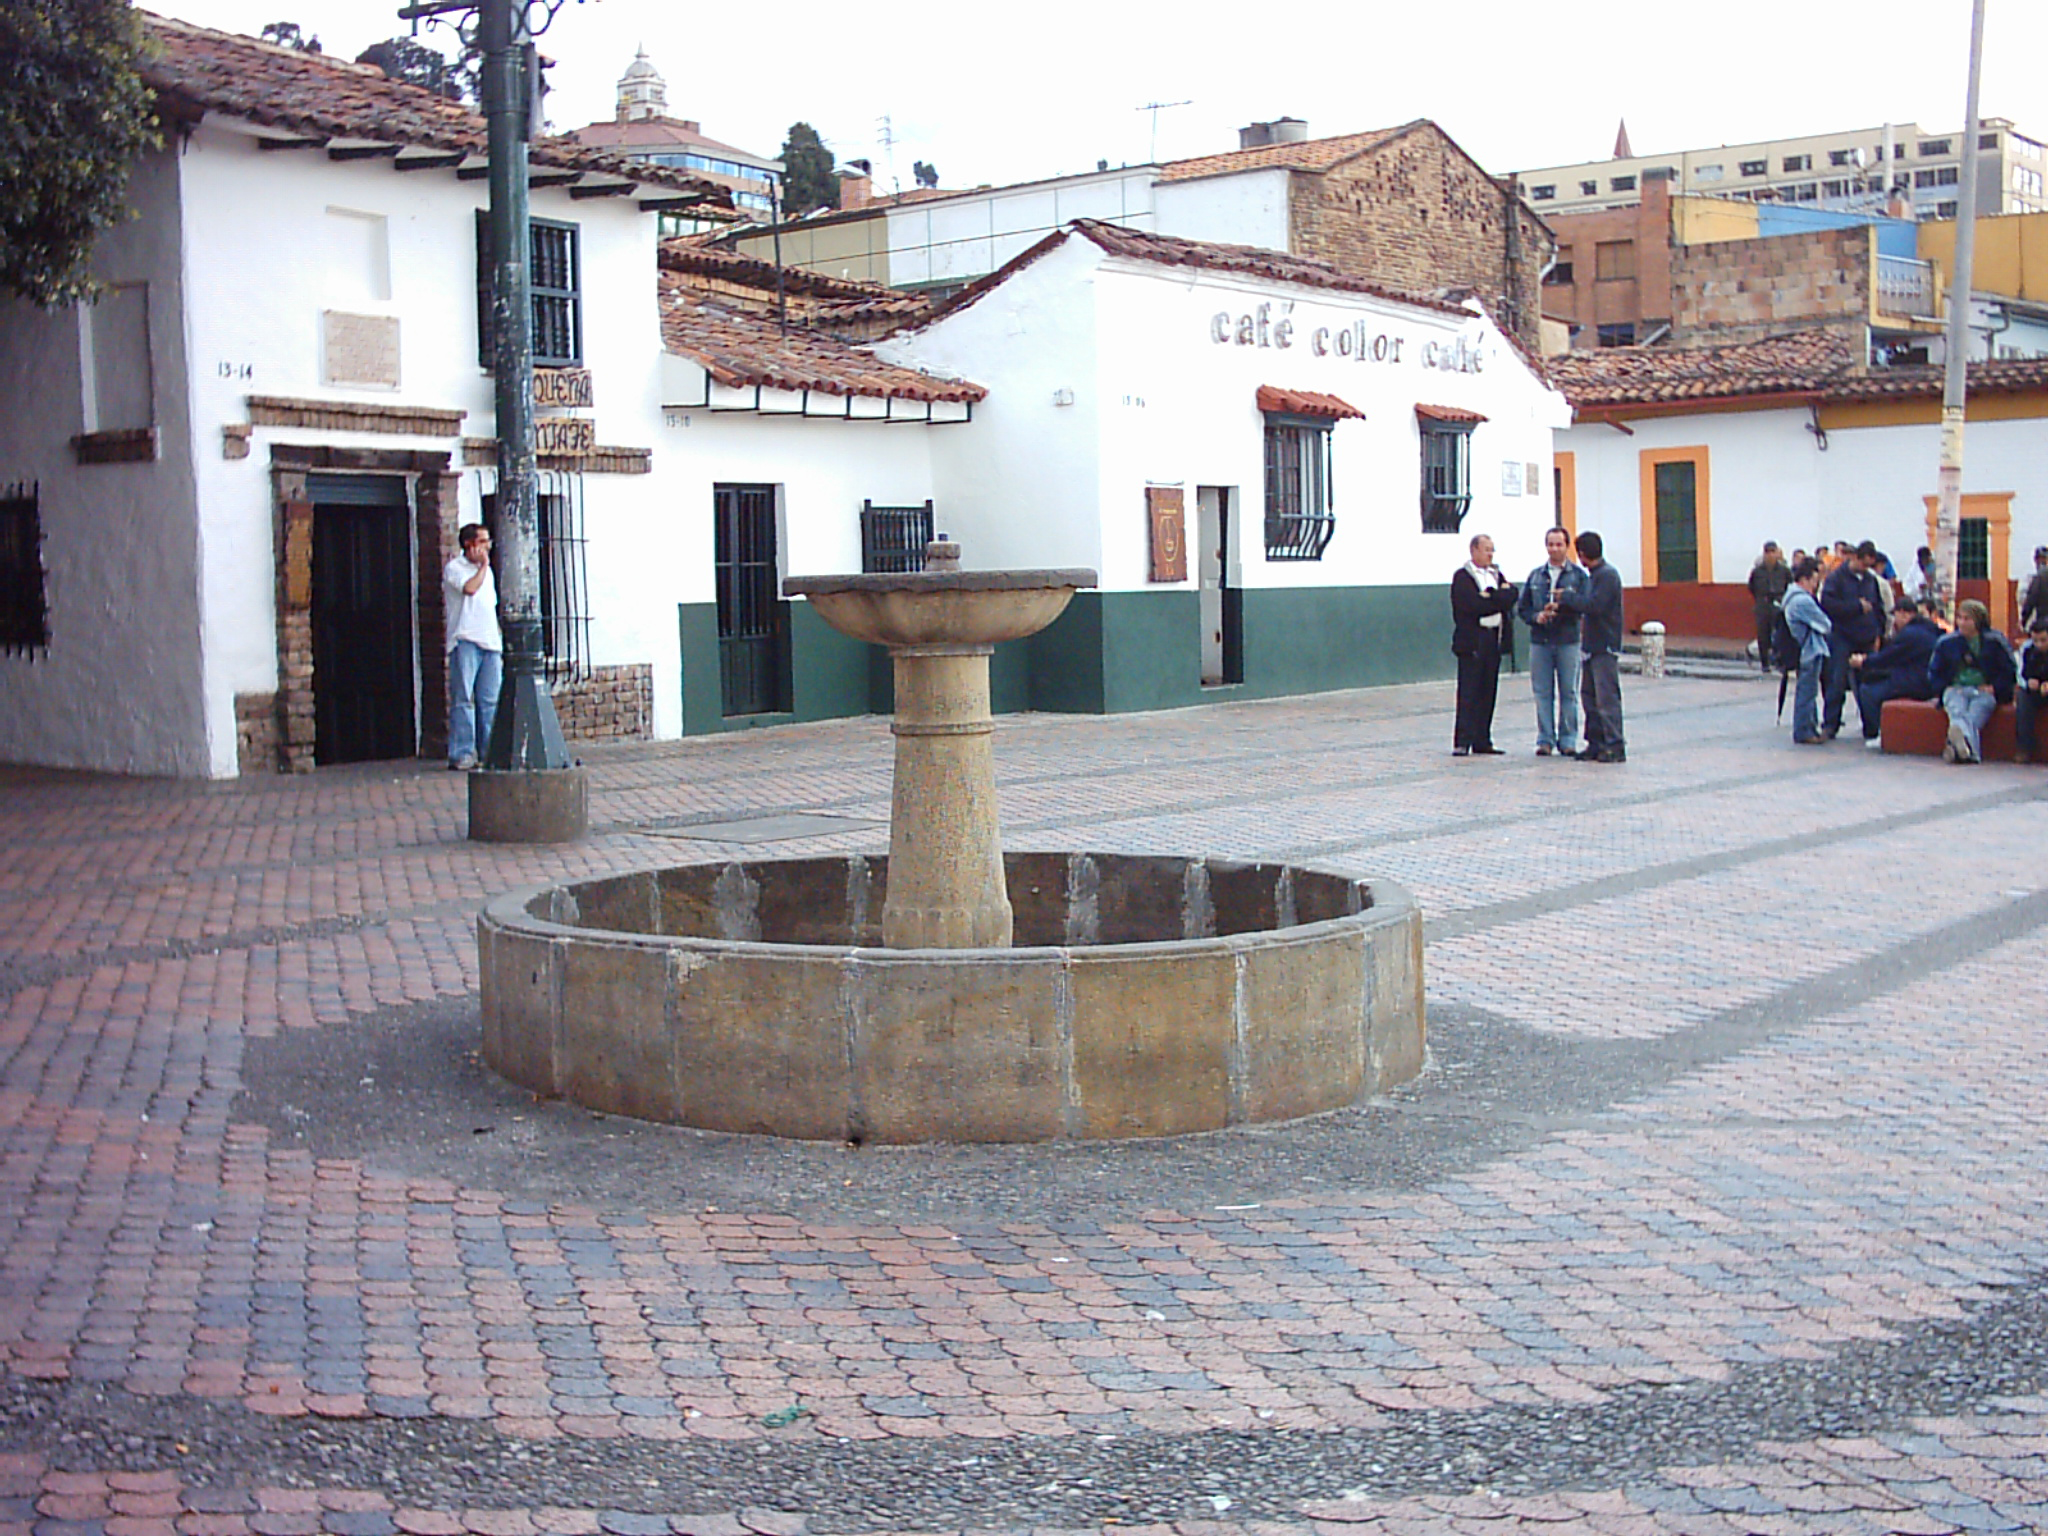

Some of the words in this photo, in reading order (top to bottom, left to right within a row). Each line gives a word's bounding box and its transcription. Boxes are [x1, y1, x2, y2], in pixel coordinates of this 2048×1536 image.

[1210, 299, 1295, 349] café
[1311, 319, 1404, 364] color
[217, 361, 253, 380] 13-14
[533, 371, 590, 403] QUEÑA
